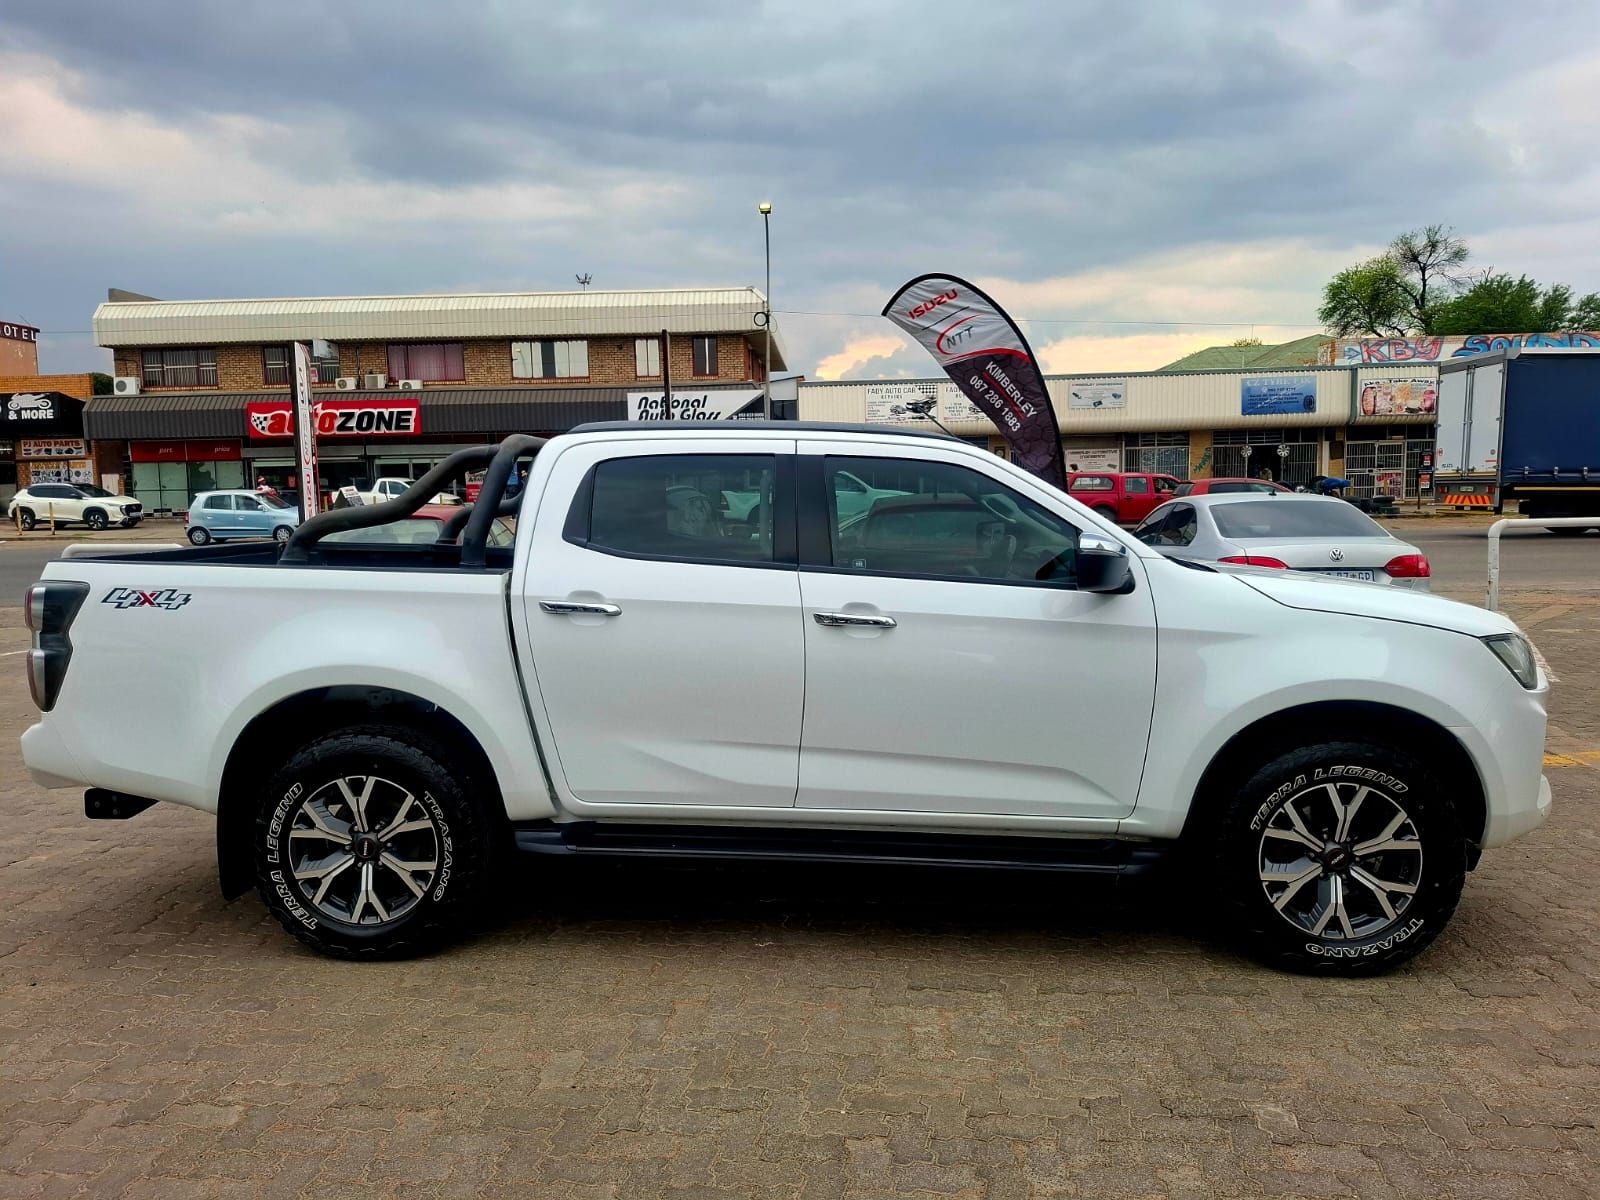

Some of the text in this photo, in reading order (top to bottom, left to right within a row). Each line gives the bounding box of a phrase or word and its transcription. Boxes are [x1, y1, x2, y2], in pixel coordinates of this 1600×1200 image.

[907, 288, 958, 320] ISUZU
[946, 325, 974, 349] NTT
[638, 395, 708, 409] Natonal
[969, 375, 1021, 432] 087 286 1883
[985, 361, 1038, 418] KIMBERLEY
[8, 409, 54, 420] & MORE
[267, 403, 413, 434] aoZONE
[680, 408, 721, 420] Glass
[1250, 765, 1409, 832] TERRA LEGEND
[267, 782, 319, 931] TERRA LEGEND
[424, 790, 453, 902] TRAZANO
[1306, 917, 1425, 958] TRAZANO
